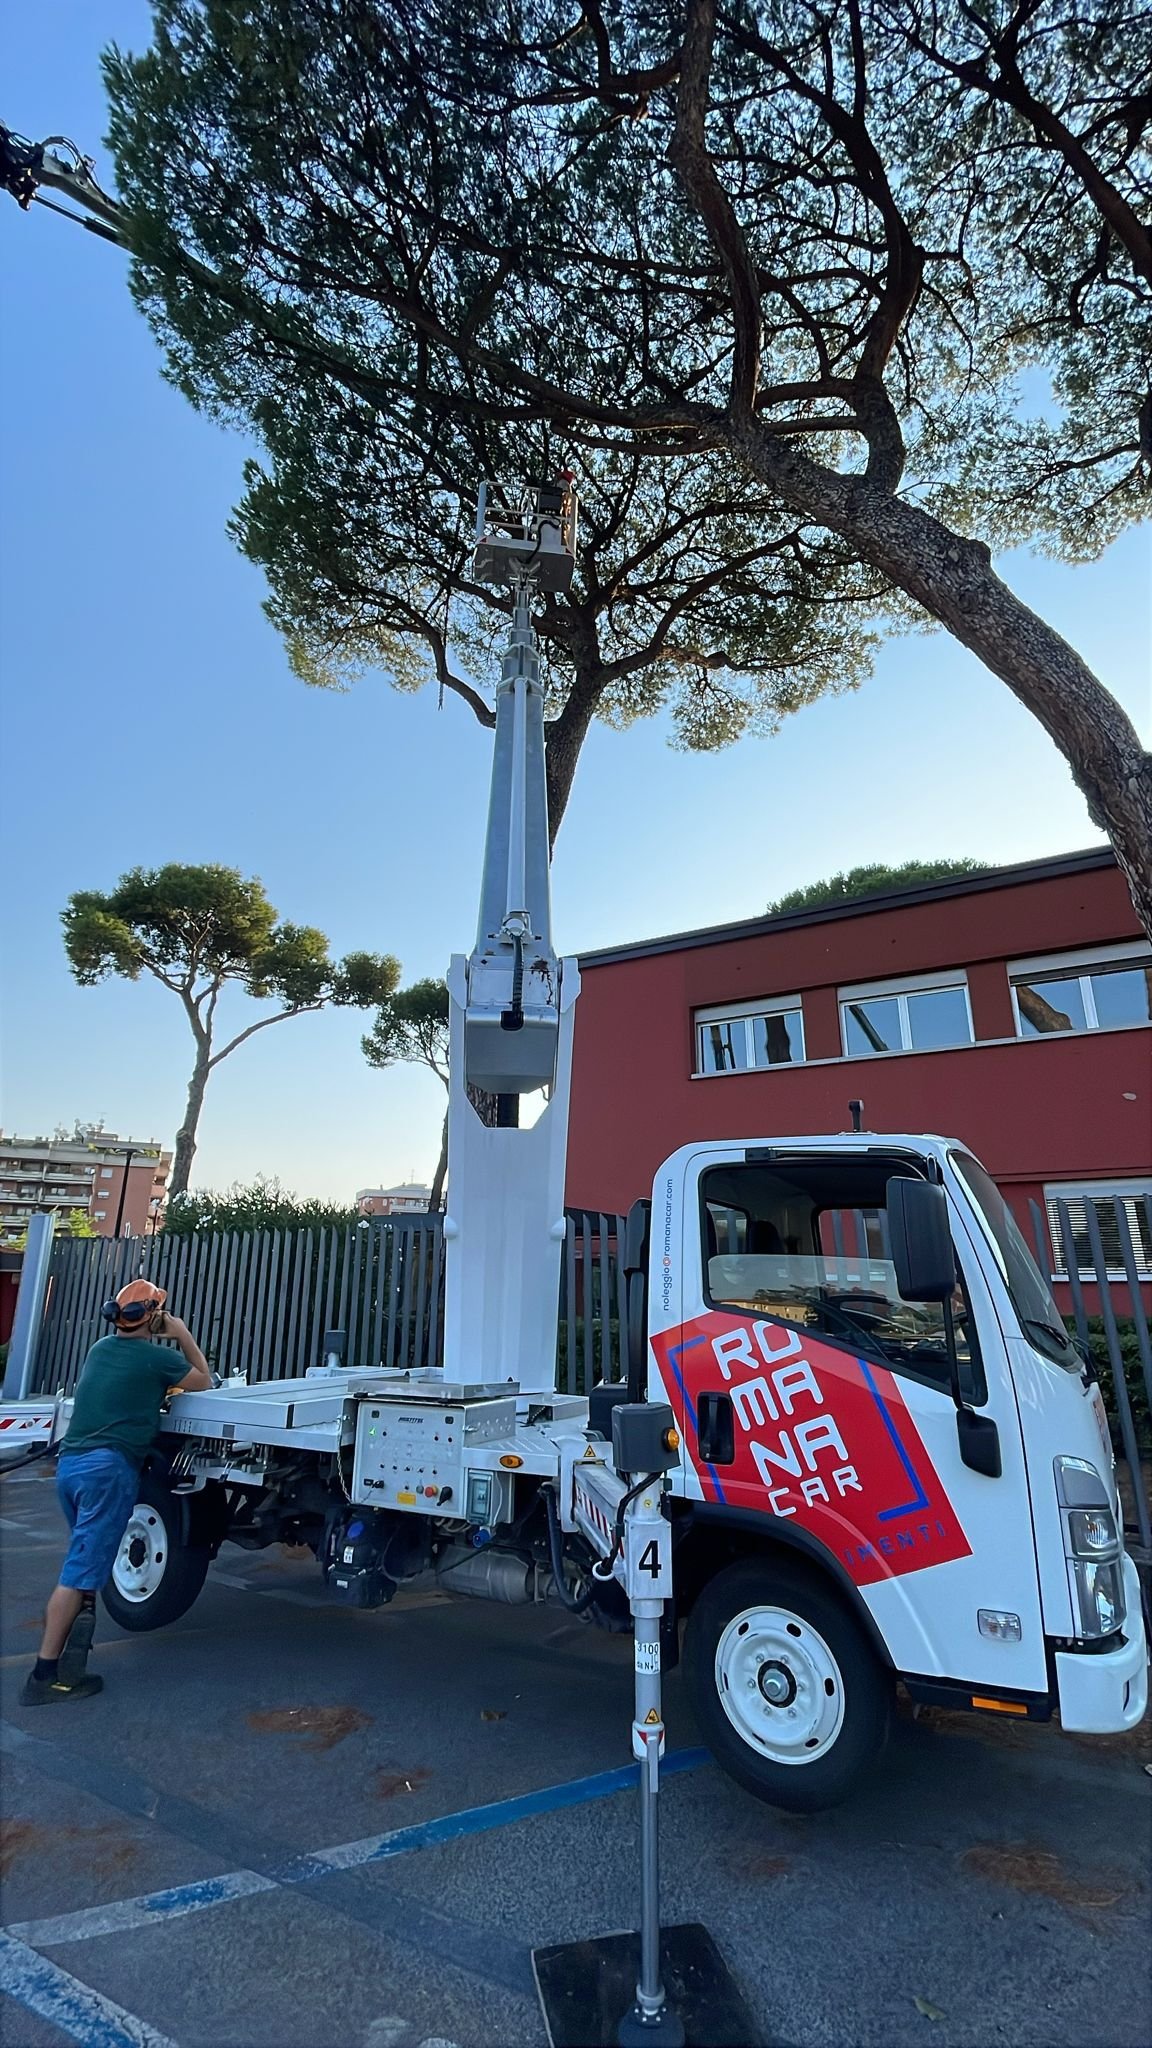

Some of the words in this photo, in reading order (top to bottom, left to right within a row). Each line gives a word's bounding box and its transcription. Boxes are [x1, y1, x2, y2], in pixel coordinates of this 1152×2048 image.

[711, 1319, 802, 1381] RO
[729, 1359, 824, 1431] MA
[749, 1413, 849, 1488] NA
[767, 1465, 863, 1518] CAR
[638, 1539, 662, 1579] 4
